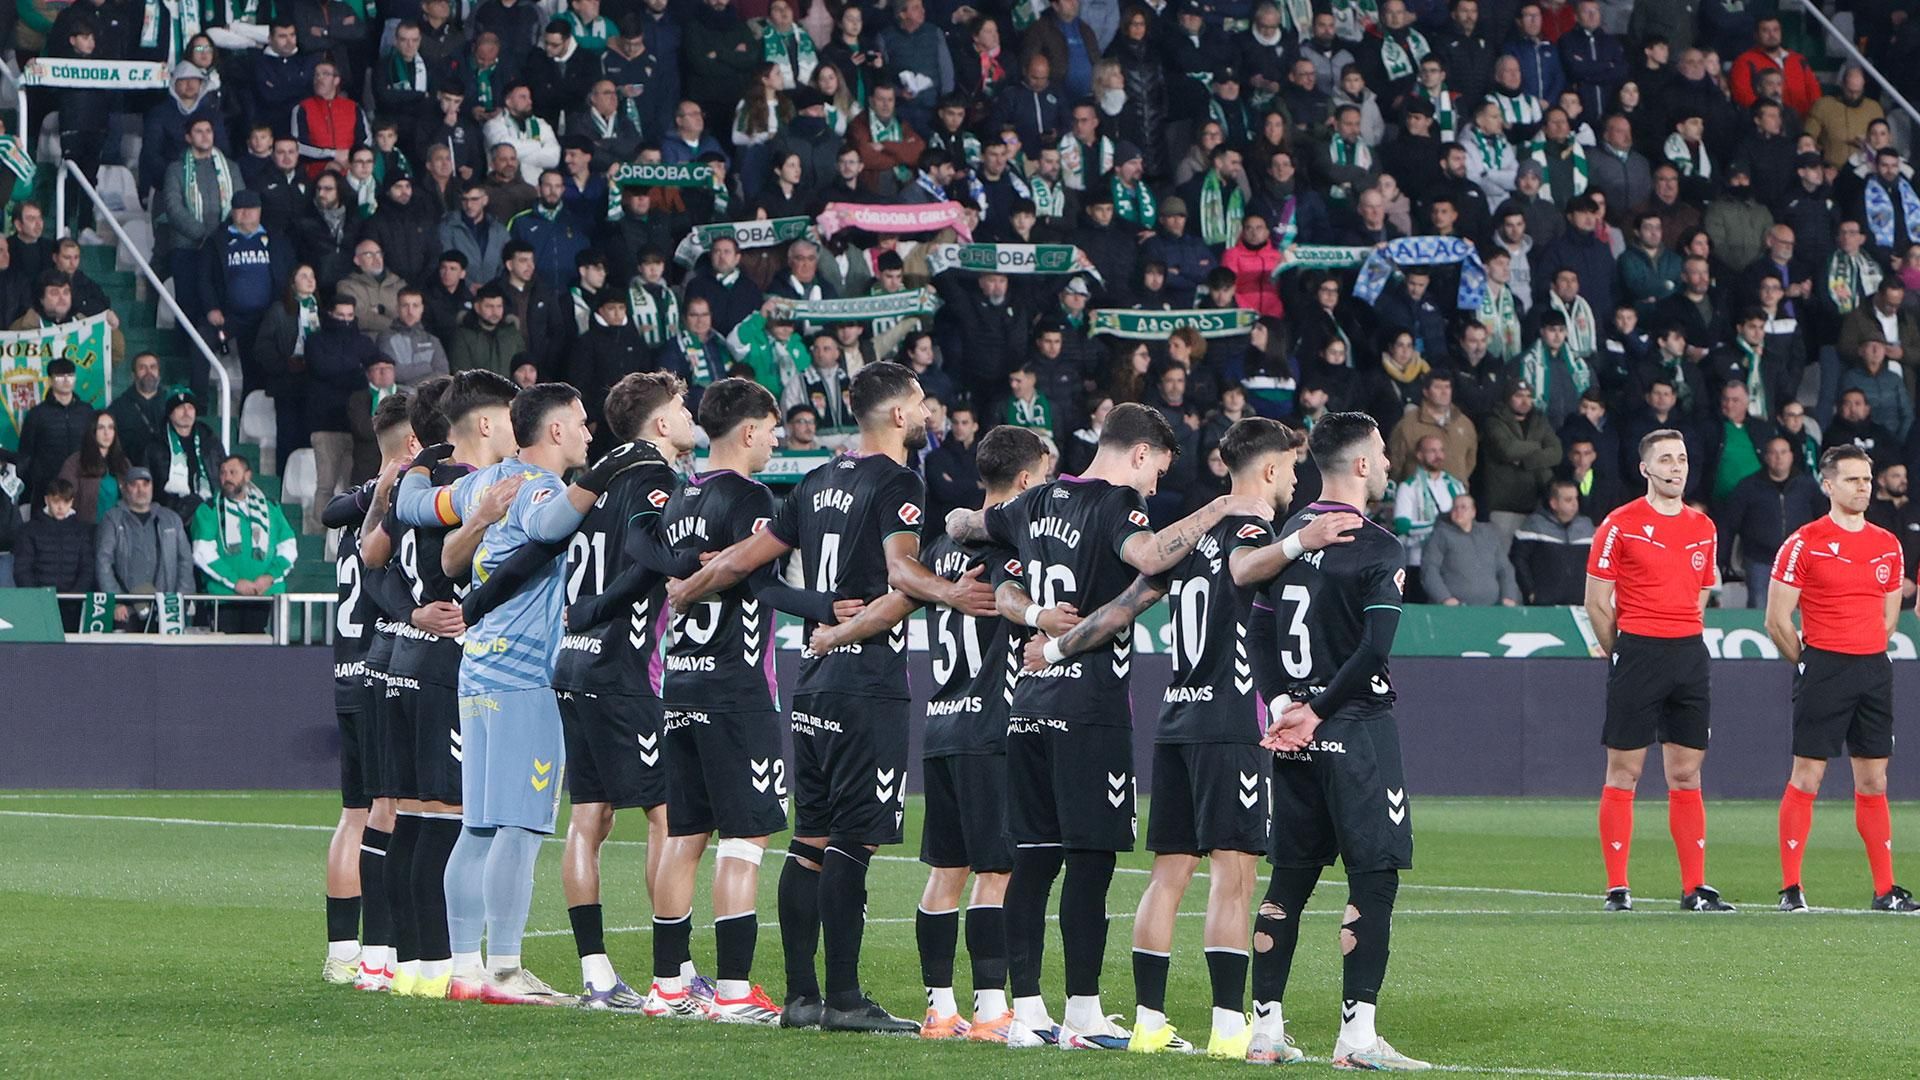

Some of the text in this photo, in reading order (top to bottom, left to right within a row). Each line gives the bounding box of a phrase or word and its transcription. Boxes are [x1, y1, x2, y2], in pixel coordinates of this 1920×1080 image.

[51, 65, 120, 81] CÓRDOBA
[813, 488, 854, 514] EINAR
[566, 531, 606, 605] 21
[935, 551, 970, 577] RAFIT
[1280, 584, 1314, 679] 3
[823, 720, 843, 733] SOL
[1320, 741, 1346, 753] SOL
